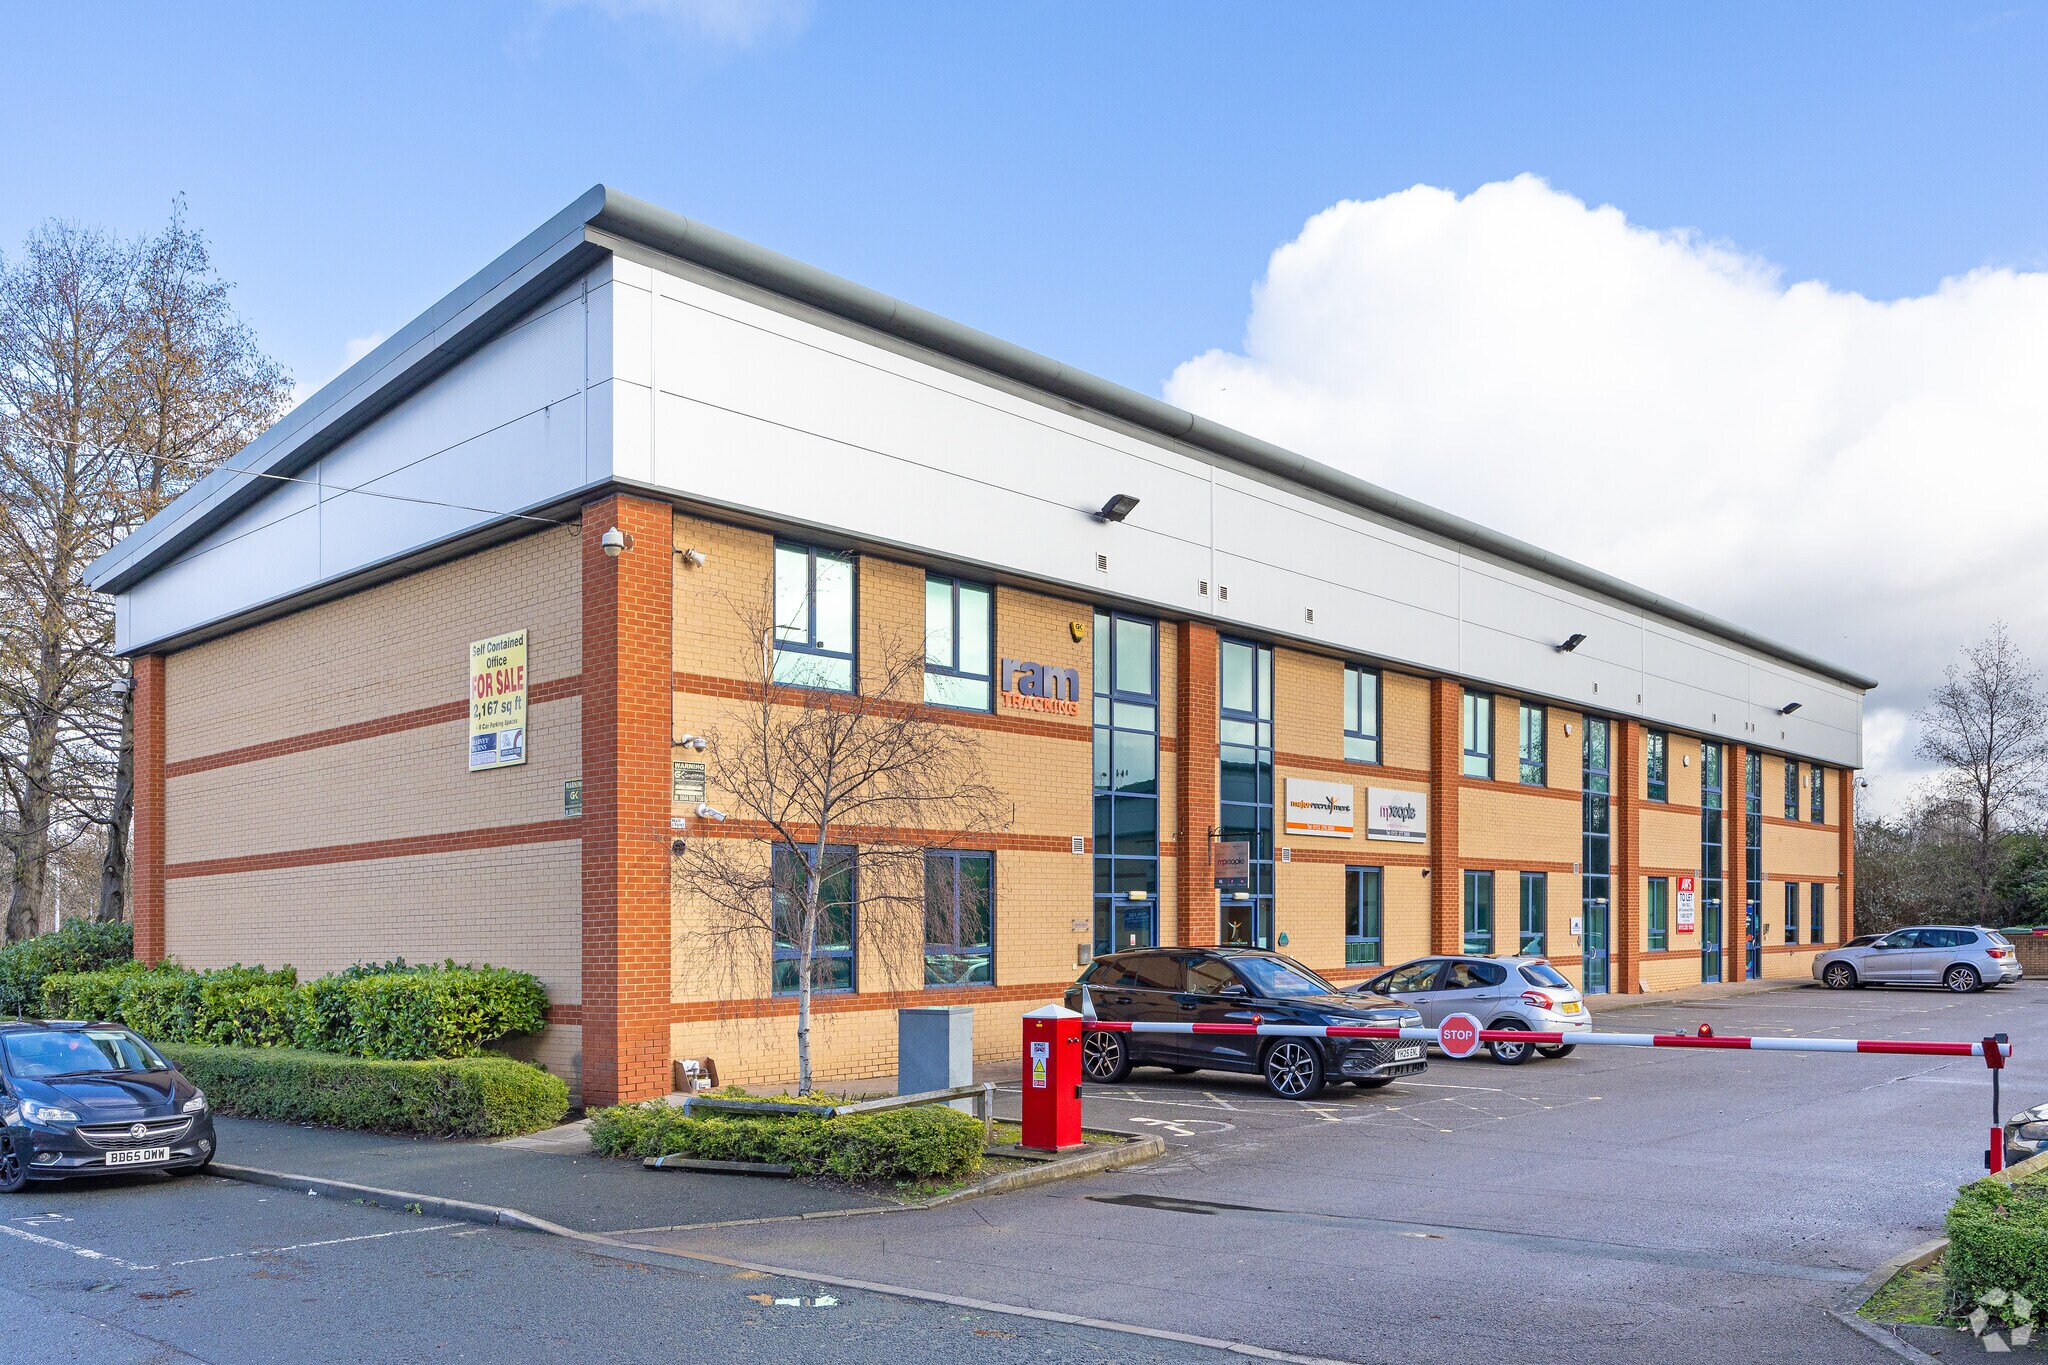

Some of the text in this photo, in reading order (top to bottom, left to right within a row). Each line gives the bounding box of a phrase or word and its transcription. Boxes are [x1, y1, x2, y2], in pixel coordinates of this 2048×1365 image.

[1075, 623, 1083, 631] GK
[472, 634, 524, 657] Self Contained
[486, 655, 508, 669] Office
[472, 665, 524, 699] FOR SALE
[1001, 657, 1079, 702] ram
[473, 695, 522, 720] 2,167 sq ft
[1001, 691, 1079, 717] TRACKING
[490, 720, 504, 729] Parking
[504, 718, 518, 727] Spaces
[674, 770, 686, 779] GK
[570, 790, 579, 800] GK
[1217, 857, 1245, 867] mpeople
[1680, 893, 1685, 902] TO
[1443, 1029, 1473, 1040] STOP
[111, 1149, 164, 1162] BD65 OWW
